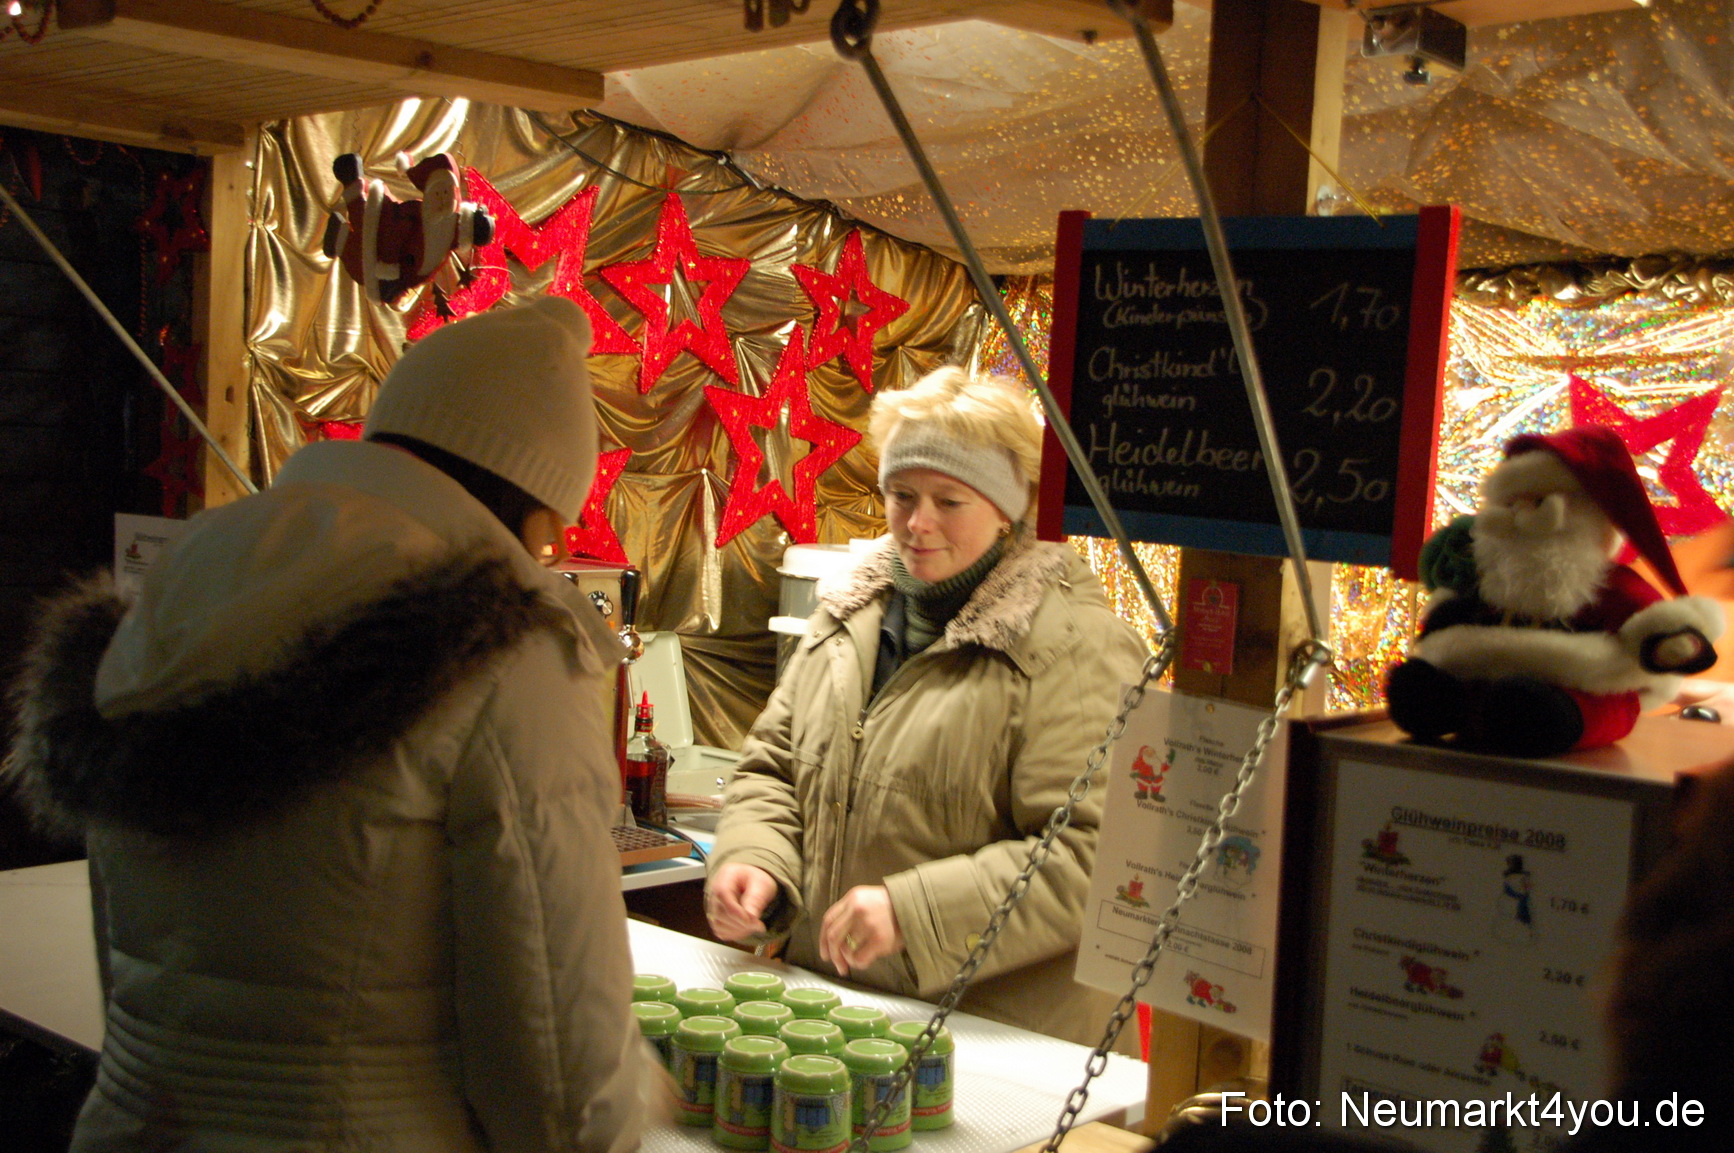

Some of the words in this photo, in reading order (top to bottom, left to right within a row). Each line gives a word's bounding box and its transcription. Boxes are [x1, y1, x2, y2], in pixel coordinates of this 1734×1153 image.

[1309, 282, 1400, 332] 1,70
[1101, 384, 1196, 418] glühwein
[1301, 367, 1398, 429] 2,20
[1088, 422, 1264, 473] Heidelbeer
[1289, 447, 1391, 514] 2,50
[1136, 799, 1174, 817] Vollrath's
[1390, 805, 1521, 846] Glühweinpreise
[1525, 827, 1566, 852] 2008
[1126, 859, 1163, 877] Vollrath's
